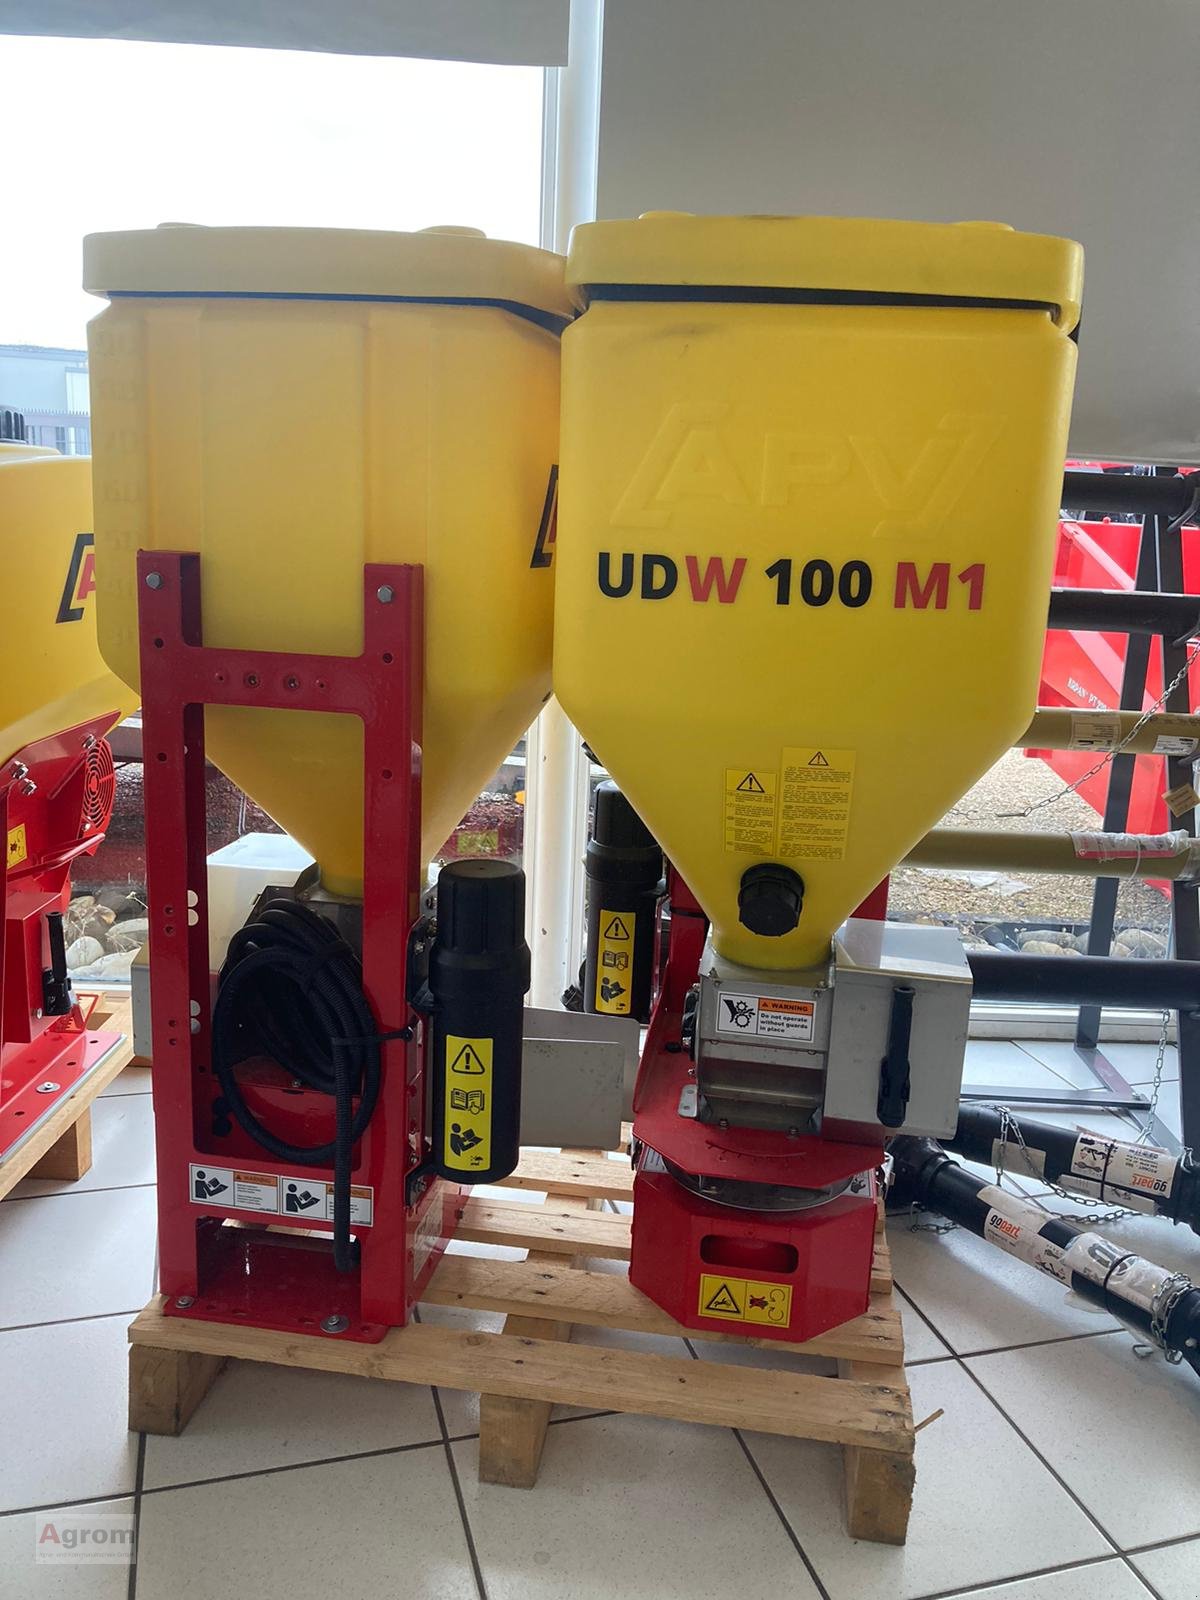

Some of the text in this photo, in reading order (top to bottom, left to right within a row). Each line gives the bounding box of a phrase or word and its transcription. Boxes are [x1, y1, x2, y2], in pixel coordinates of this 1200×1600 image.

[598, 552, 986, 611] UDW 100 M1
[771, 1003, 808, 1012] WARNING
[783, 1015, 808, 1023] operate
[786, 1022, 808, 1030] guards
[990, 1214, 1021, 1240] gopart
